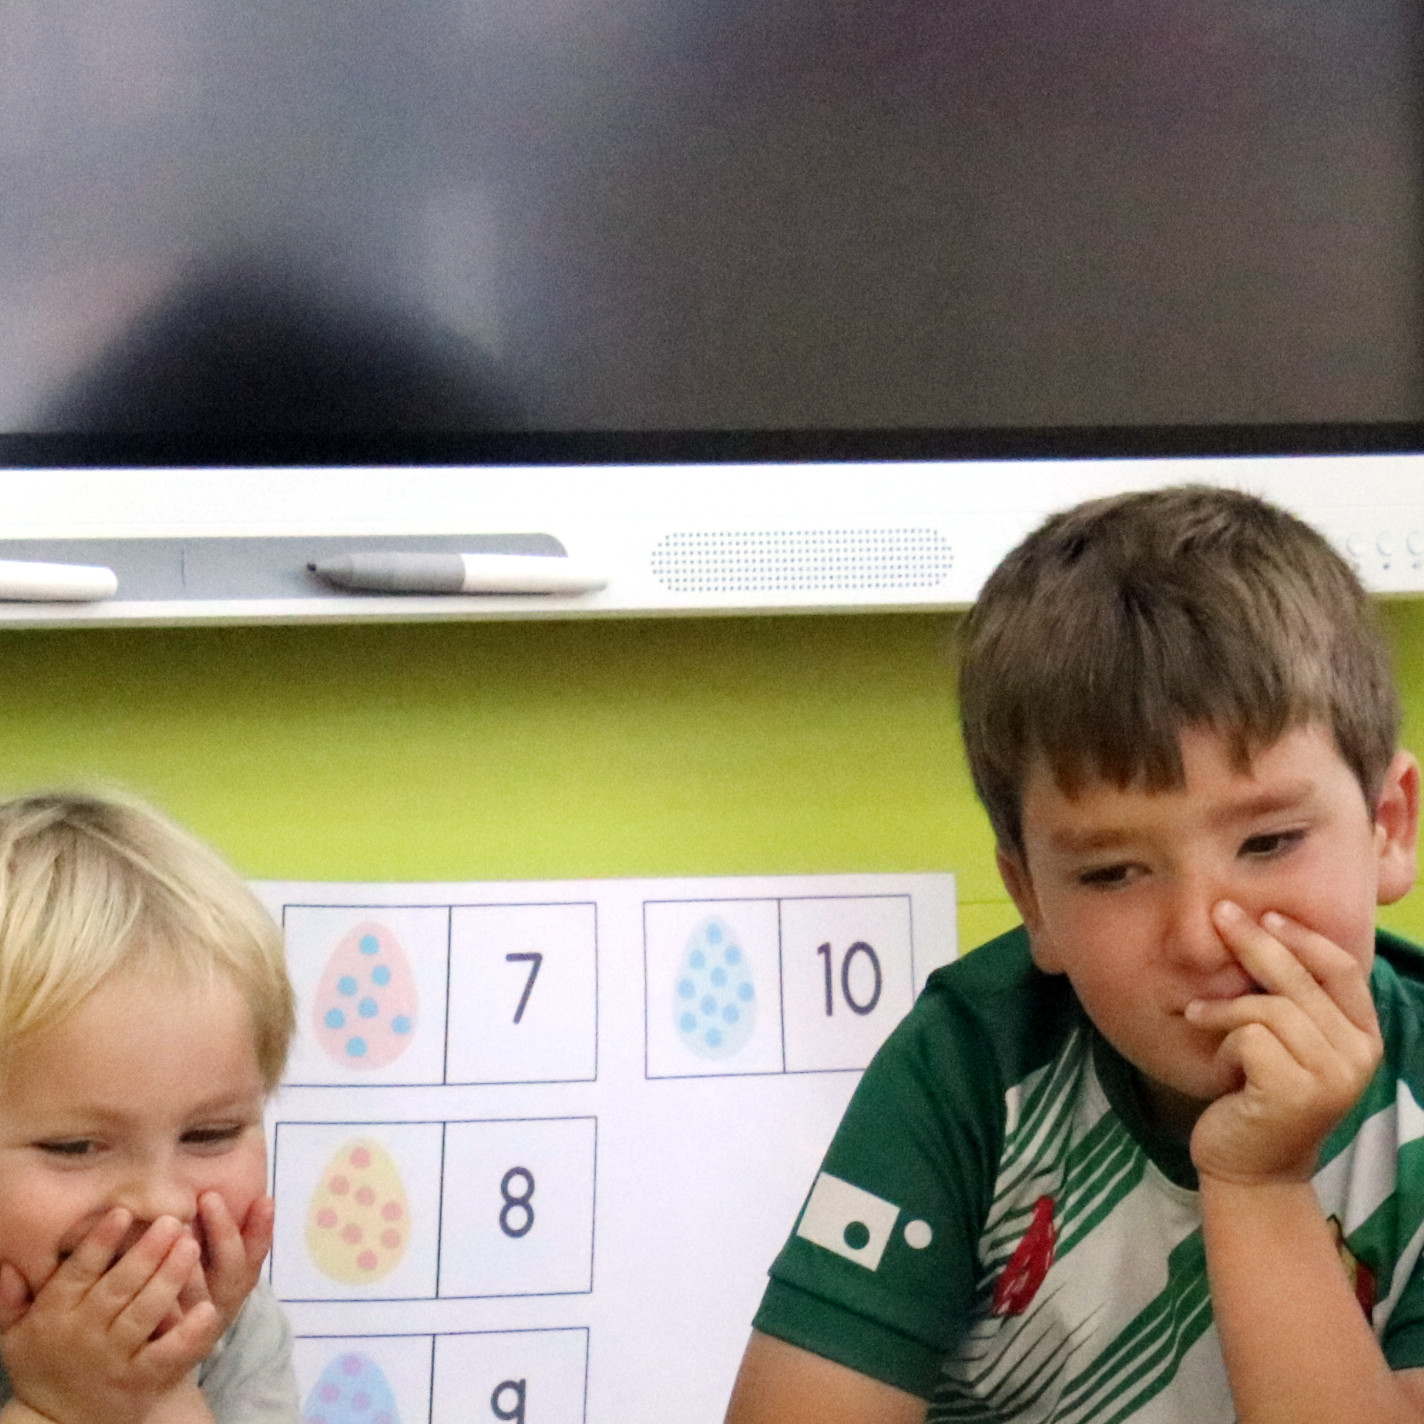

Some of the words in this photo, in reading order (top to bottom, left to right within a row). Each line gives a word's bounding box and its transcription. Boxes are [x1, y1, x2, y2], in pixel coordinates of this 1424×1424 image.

[505, 952, 543, 1024] 7
[816, 941, 883, 1017] 10
[498, 1166, 535, 1238] 8
